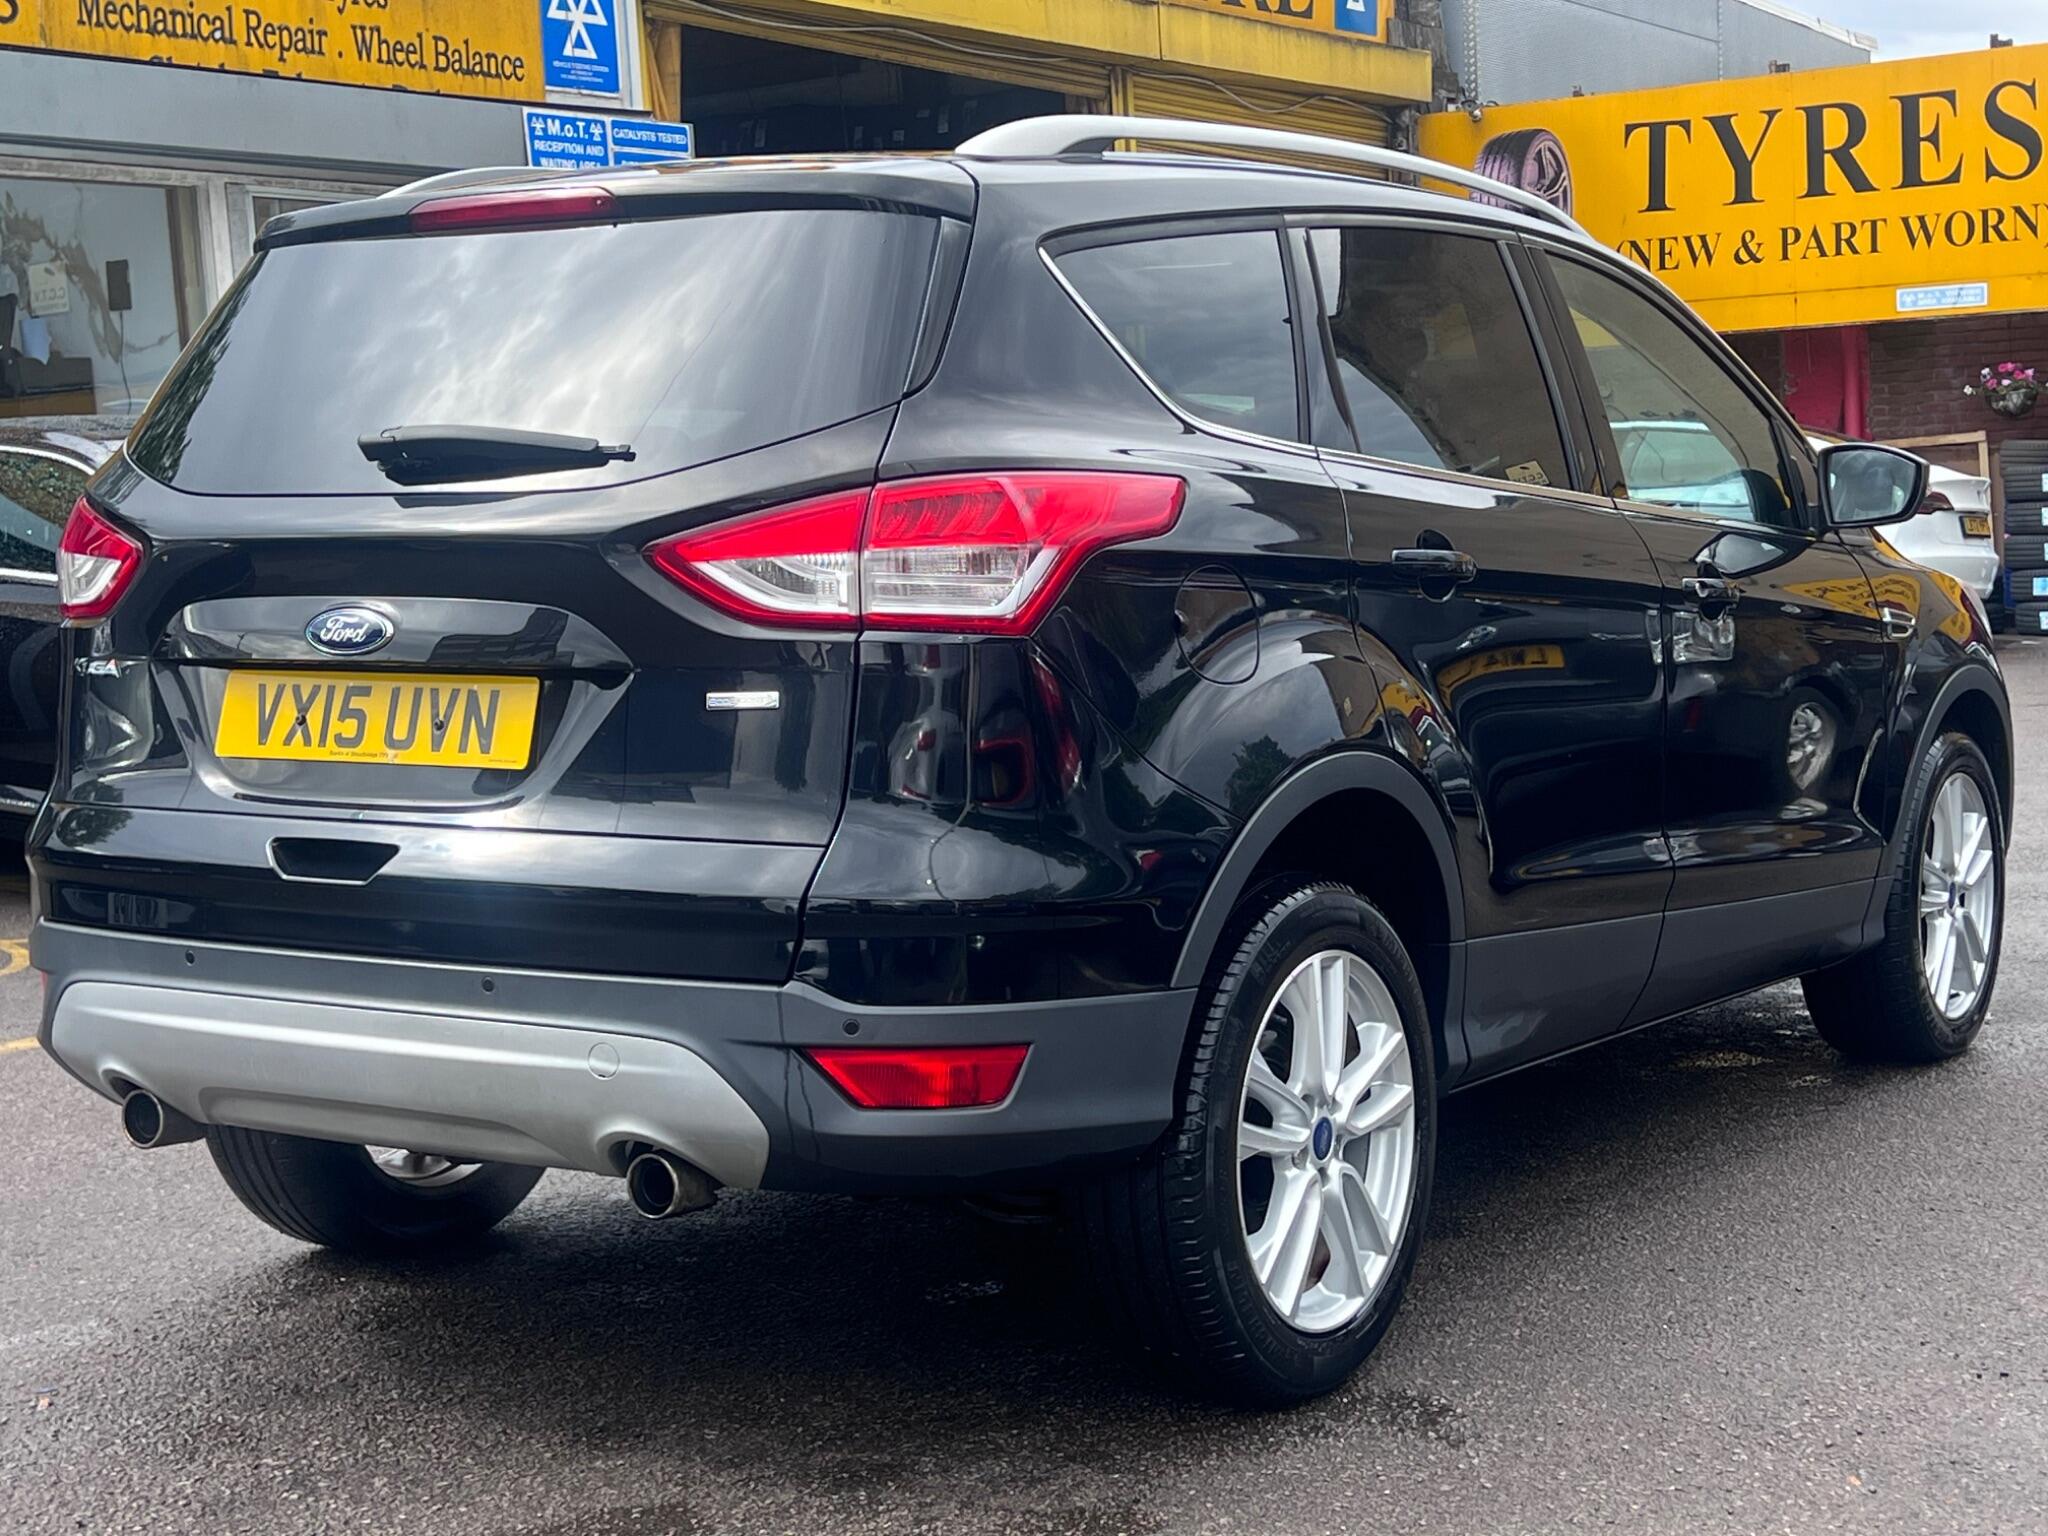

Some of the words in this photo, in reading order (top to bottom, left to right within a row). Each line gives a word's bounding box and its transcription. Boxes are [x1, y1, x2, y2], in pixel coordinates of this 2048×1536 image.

[77, 0, 237, 46] Mechanical
[243, 9, 328, 62] Repair
[351, 24, 428, 70] Wheel
[433, 35, 526, 82] Balance
[546, 118, 589, 139] M.o.T.
[613, 128, 657, 142] CATALYSTS
[657, 132, 687, 145] TESTED
[1624, 77, 2043, 213] TYRES
[534, 140, 584, 155] RECEPTION
[586, 145, 605, 157] AND
[1734, 229, 1764, 265] &
[1780, 217, 1888, 262] PART
[320, 616, 370, 642] Ford
[258, 683, 373, 749] VX15
[384, 687, 500, 755] UVN
